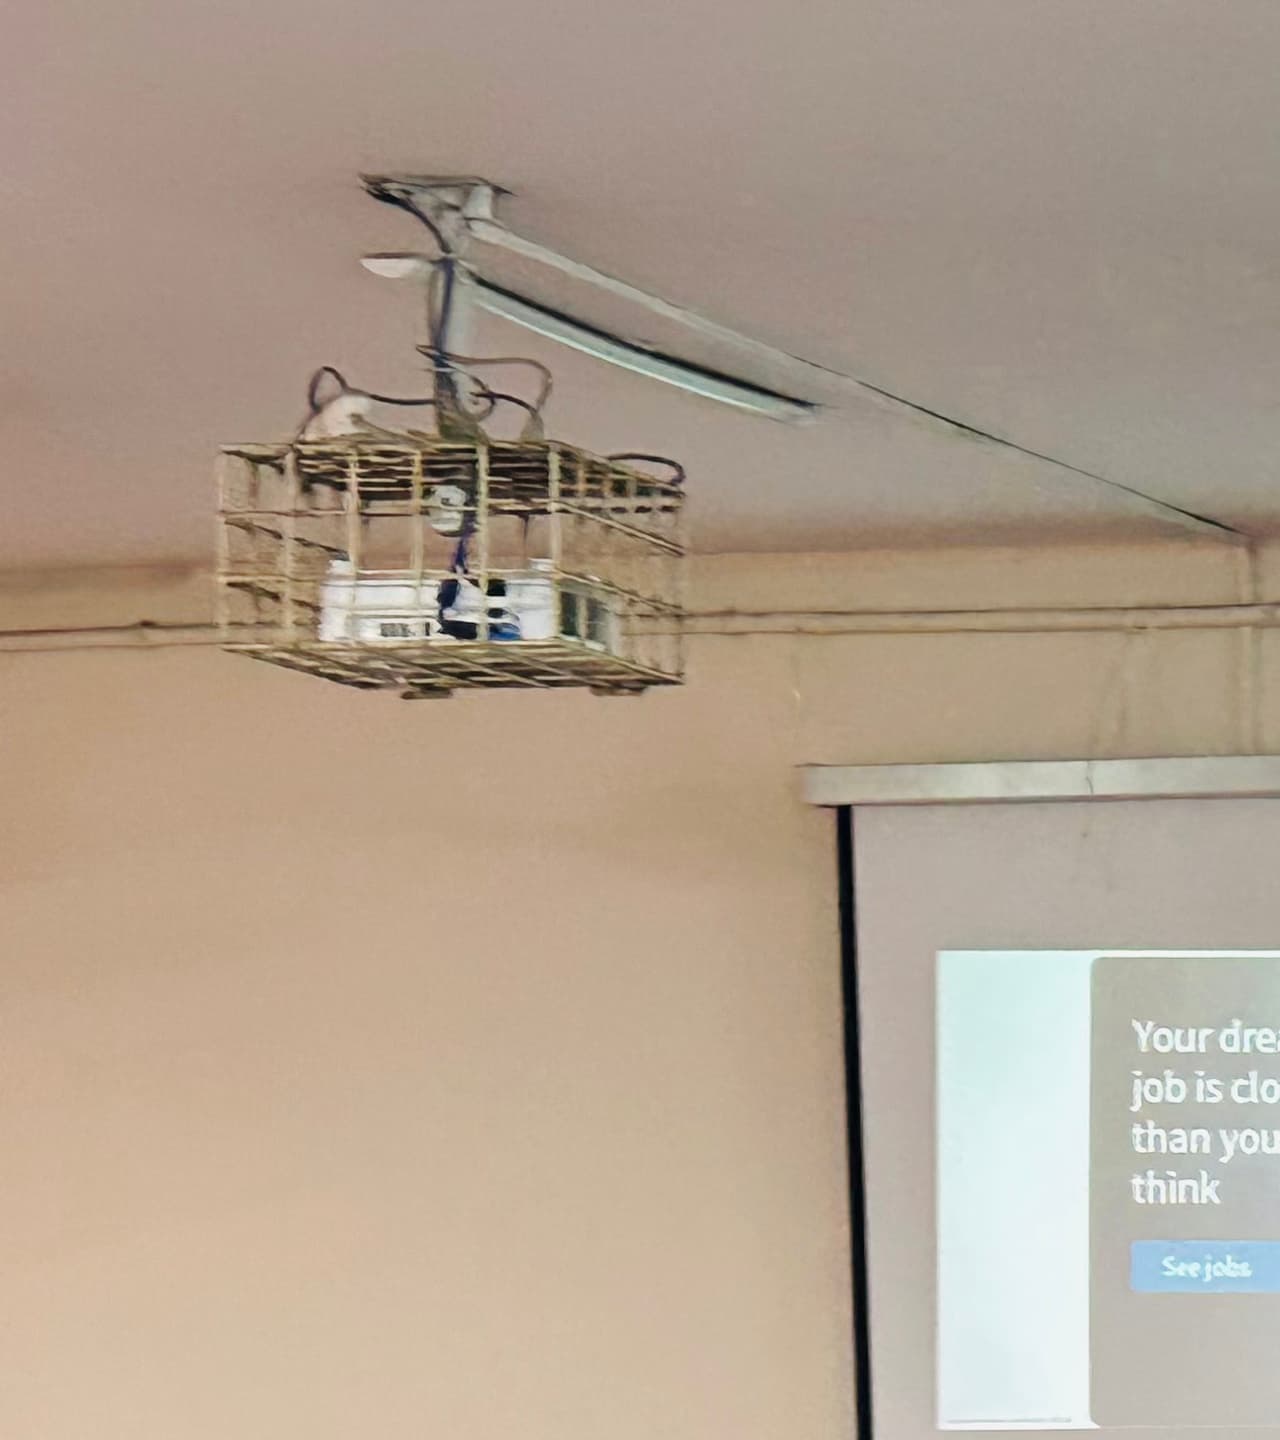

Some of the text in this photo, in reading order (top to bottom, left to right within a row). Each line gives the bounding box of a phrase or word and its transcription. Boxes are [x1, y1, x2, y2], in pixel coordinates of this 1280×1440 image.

[1130, 1018, 1216, 1053] Your
[1128, 1068, 1187, 1113] job
[1194, 1069, 1225, 1104] is
[1130, 1119, 1212, 1154] than
[1129, 1169, 1222, 1205] think
[1160, 1253, 1253, 1283] See jobs
